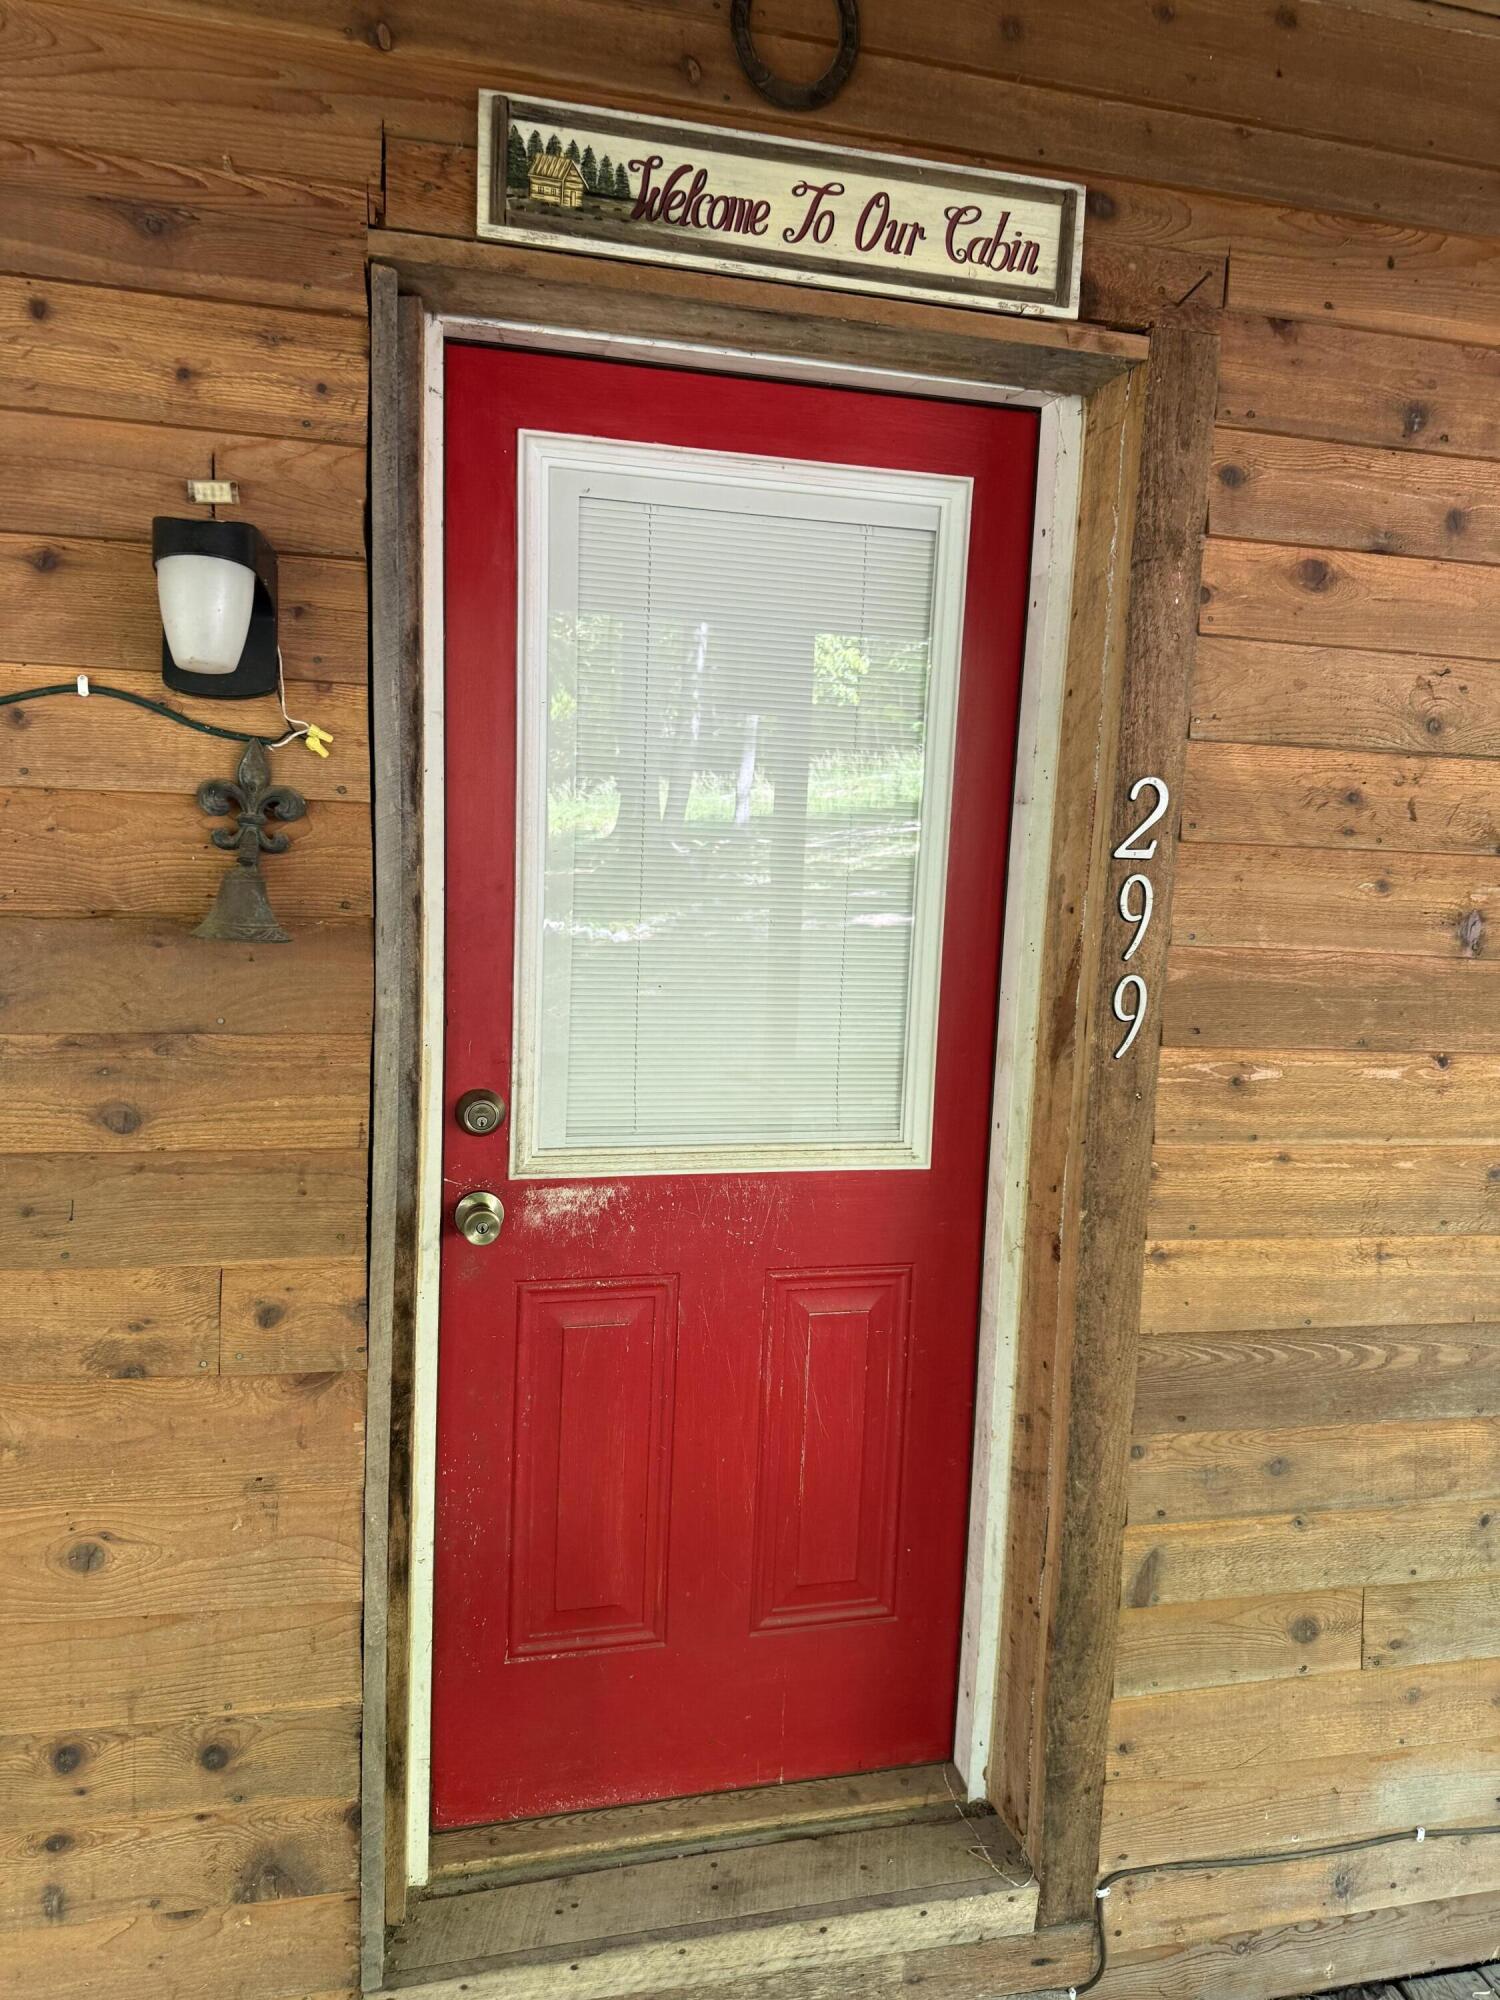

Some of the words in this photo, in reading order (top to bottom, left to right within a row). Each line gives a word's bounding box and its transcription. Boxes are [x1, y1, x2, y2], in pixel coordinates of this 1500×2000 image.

[628, 155, 771, 236] Welcome
[782, 180, 845, 244] To
[855, 191, 927, 257] Our
[943, 205, 1041, 275] Cabin
[1113, 776, 1170, 1059] 299
